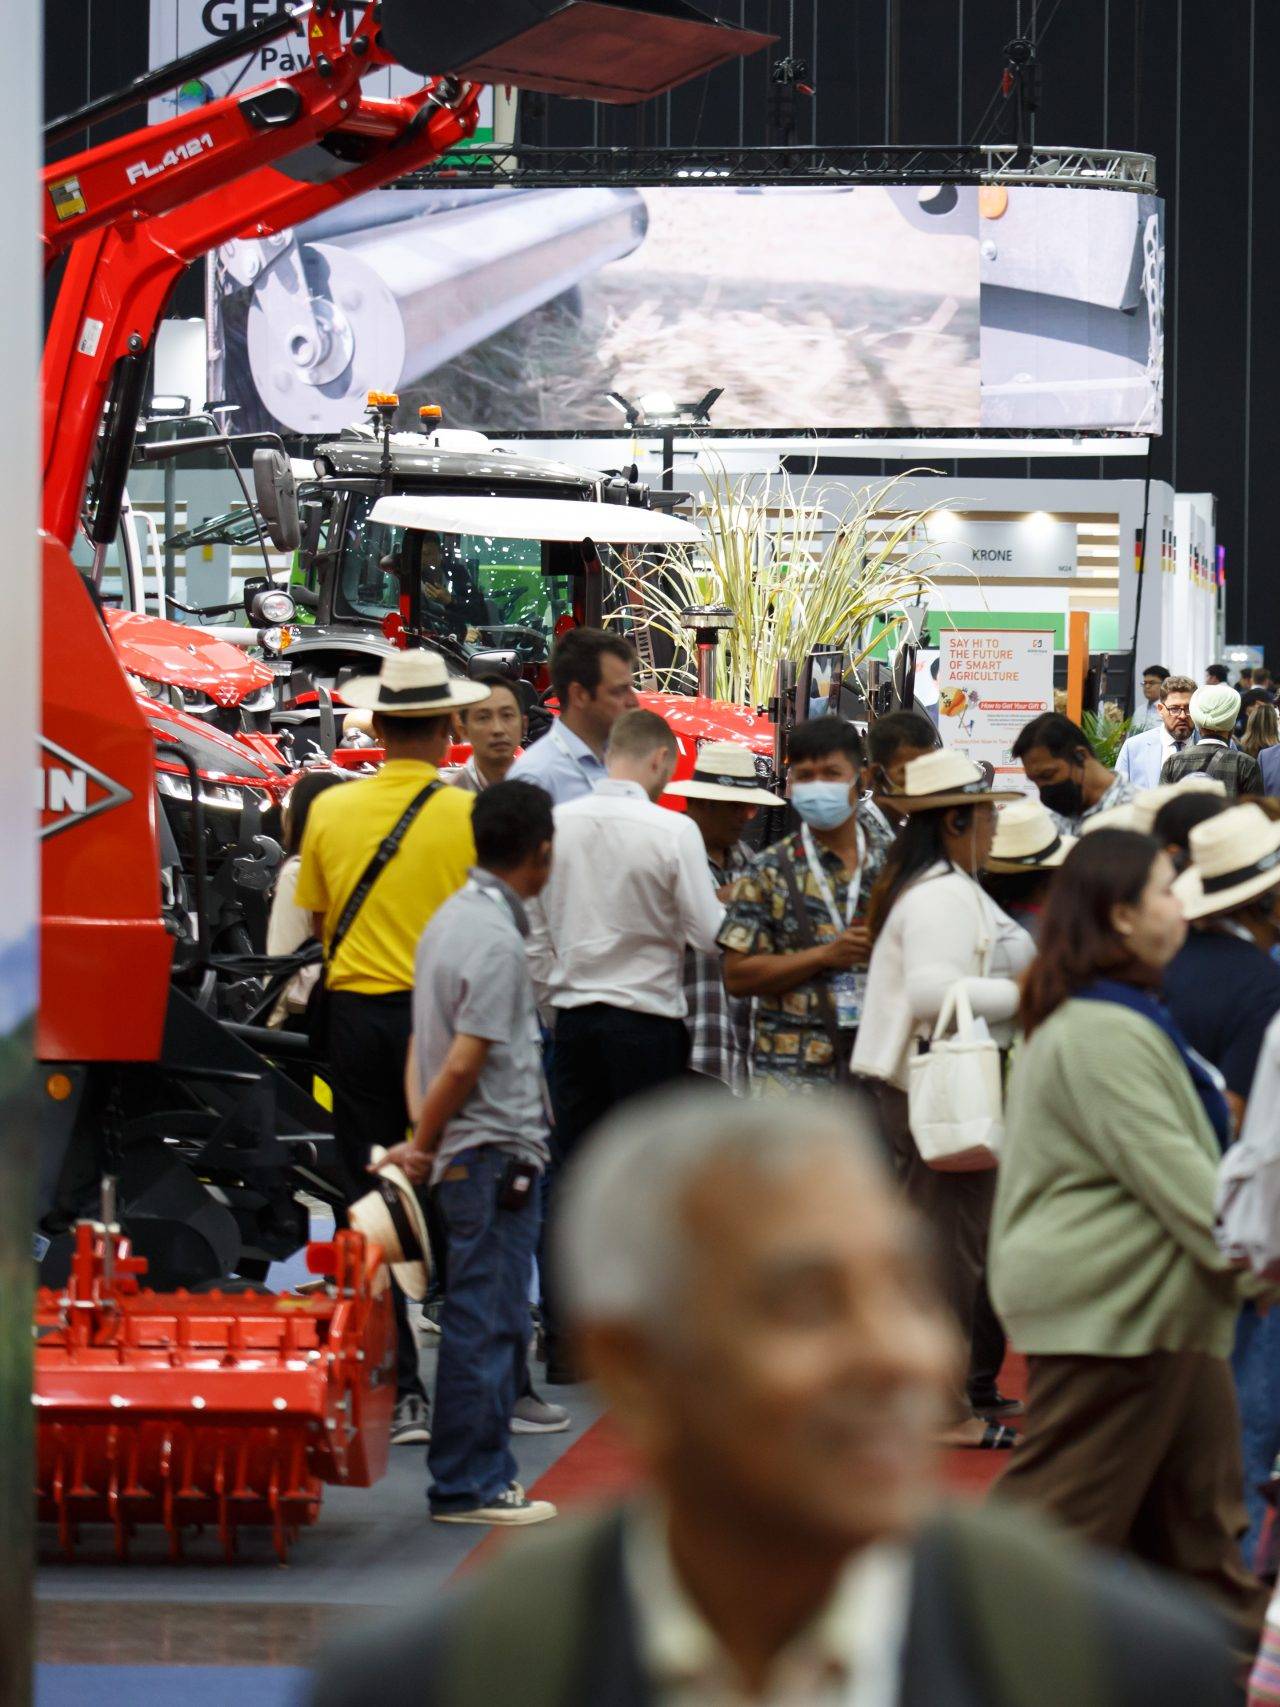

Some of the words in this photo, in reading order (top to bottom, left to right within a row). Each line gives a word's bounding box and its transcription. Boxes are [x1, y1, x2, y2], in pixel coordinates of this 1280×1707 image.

[126, 132, 215, 186] FL.4121
[972, 550, 1013, 561] KRONE
[950, 639, 969, 648] SAY
[973, 639, 983, 648] HI
[986, 639, 999, 648] TO
[950, 650, 970, 659] THE
[973, 650, 1013, 660] FUTURE
[950, 660, 963, 670] OF
[967, 661, 1002, 670] SMART
[950, 671, 1020, 681] AGRICULTURE
